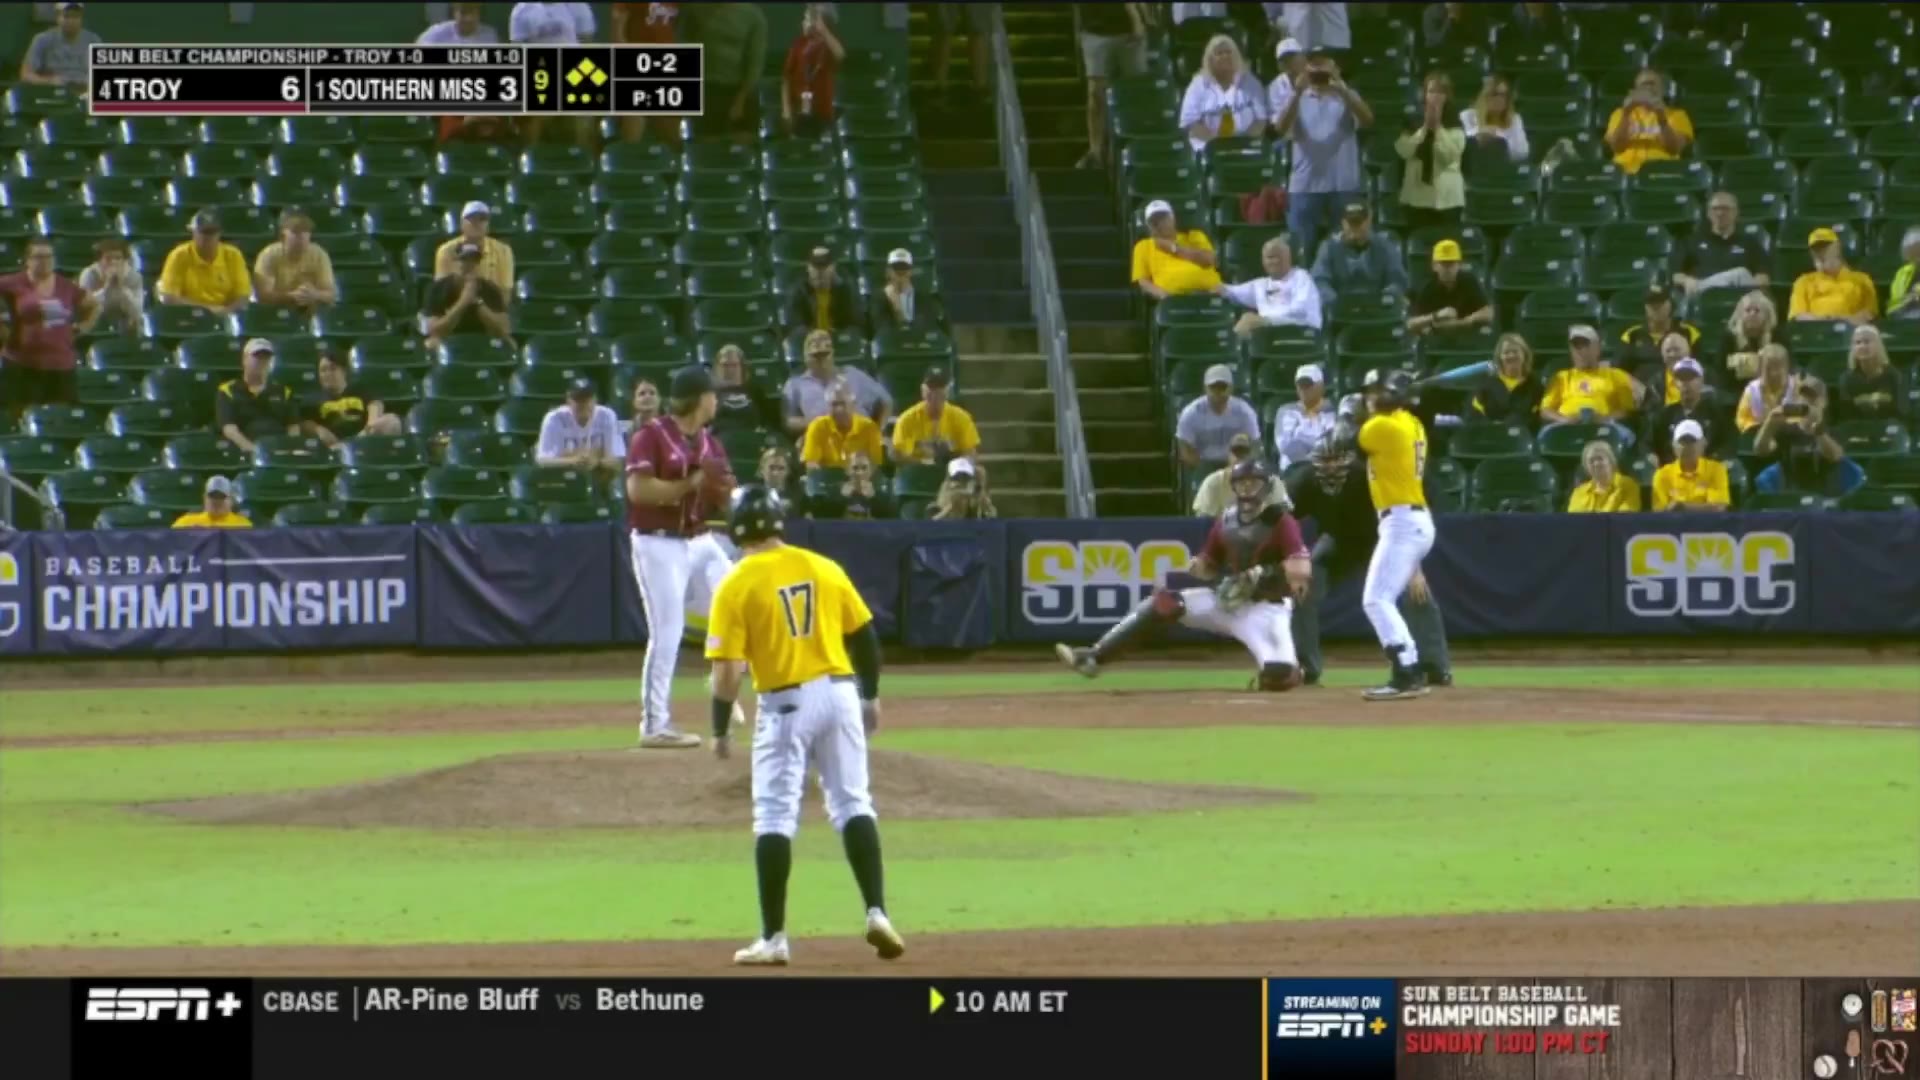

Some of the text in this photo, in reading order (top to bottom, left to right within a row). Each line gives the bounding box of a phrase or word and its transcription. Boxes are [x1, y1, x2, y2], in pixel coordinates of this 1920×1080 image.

[45, 554, 201, 577] BASEBALL
[1626, 531, 1796, 617] SBC
[43, 578, 407, 631] CHAMPIONSHIP
[777, 580, 815, 640] 17
